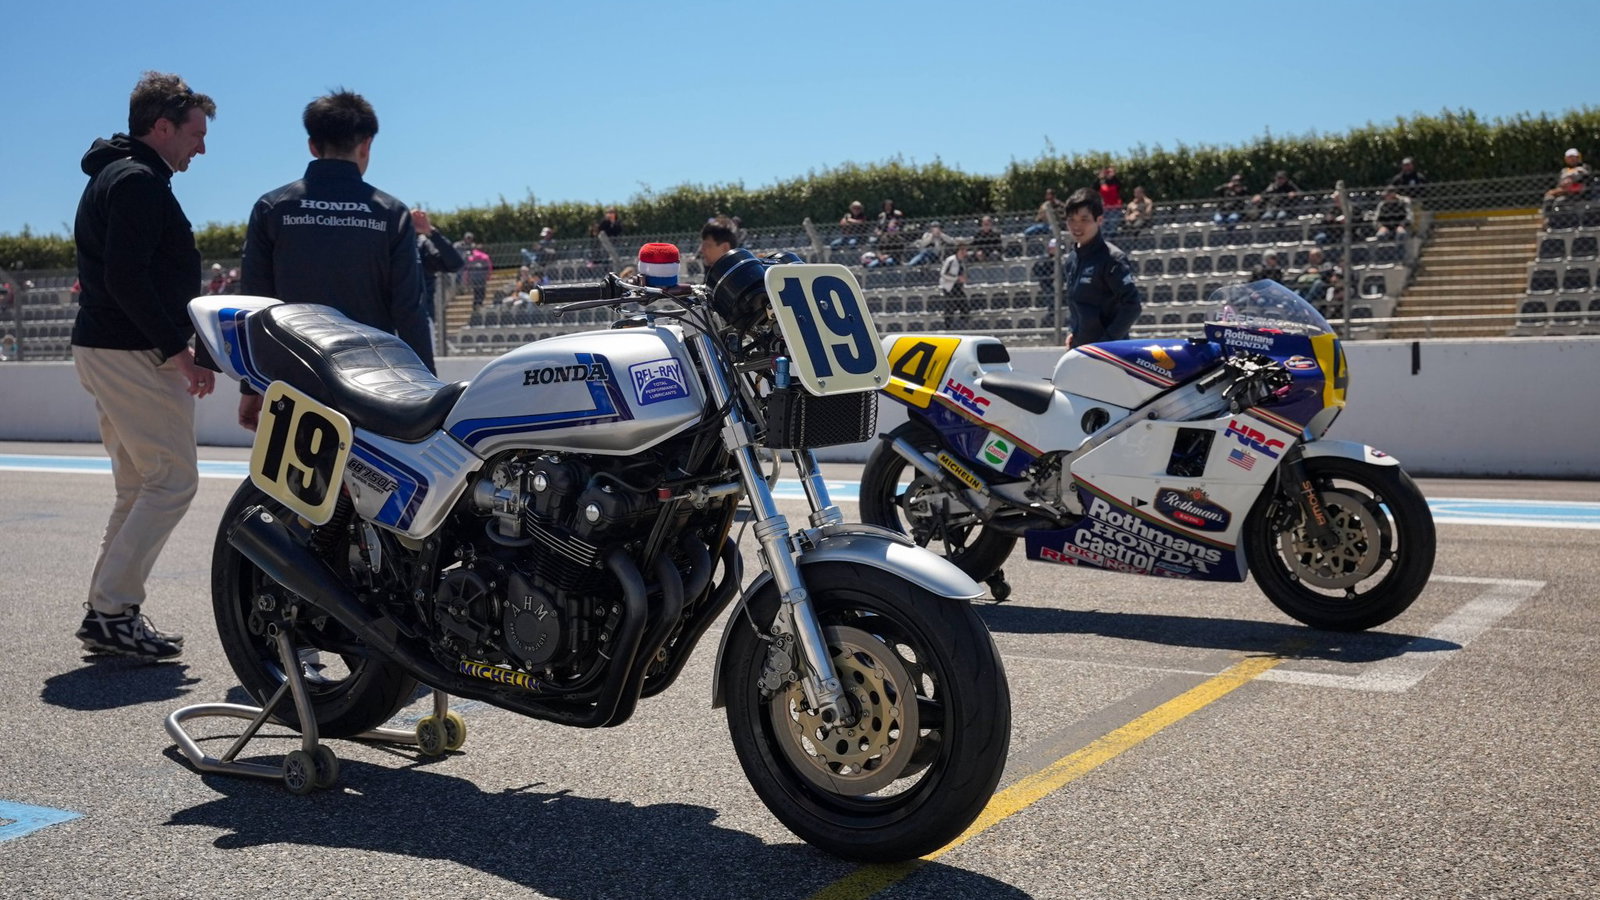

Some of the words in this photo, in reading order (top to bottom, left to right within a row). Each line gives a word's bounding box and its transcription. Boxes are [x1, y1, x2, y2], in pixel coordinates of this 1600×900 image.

[301, 200, 372, 212] HONDA
[283, 214, 315, 226] Honda
[316, 215, 367, 228] Collection
[368, 219, 387, 232] Hall
[778, 275, 878, 378] 19
[1224, 328, 1274, 346] Rothmans
[1225, 338, 1270, 351] HONDA
[522, 362, 608, 386] HONDA
[635, 364, 681, 391] BEL-RAY
[891, 341, 938, 394] 4
[1135, 357, 1172, 379] HONDA
[942, 378, 991, 417] HRC
[261, 394, 340, 507] 19
[1224, 419, 1285, 460] HRC
[939, 455, 981, 490] MICHELIN
[1162, 491, 1224, 523] Rothmans
[1302, 480, 1326, 526] SHOWA
[1088, 497, 1222, 563] Rothmans
[1042, 547, 1075, 565] RK
[1074, 528, 1154, 571] Castrol
[1090, 520, 1210, 574] HONDA
[511, 595, 549, 621] AHM
[460, 660, 543, 693] MICHELIN
